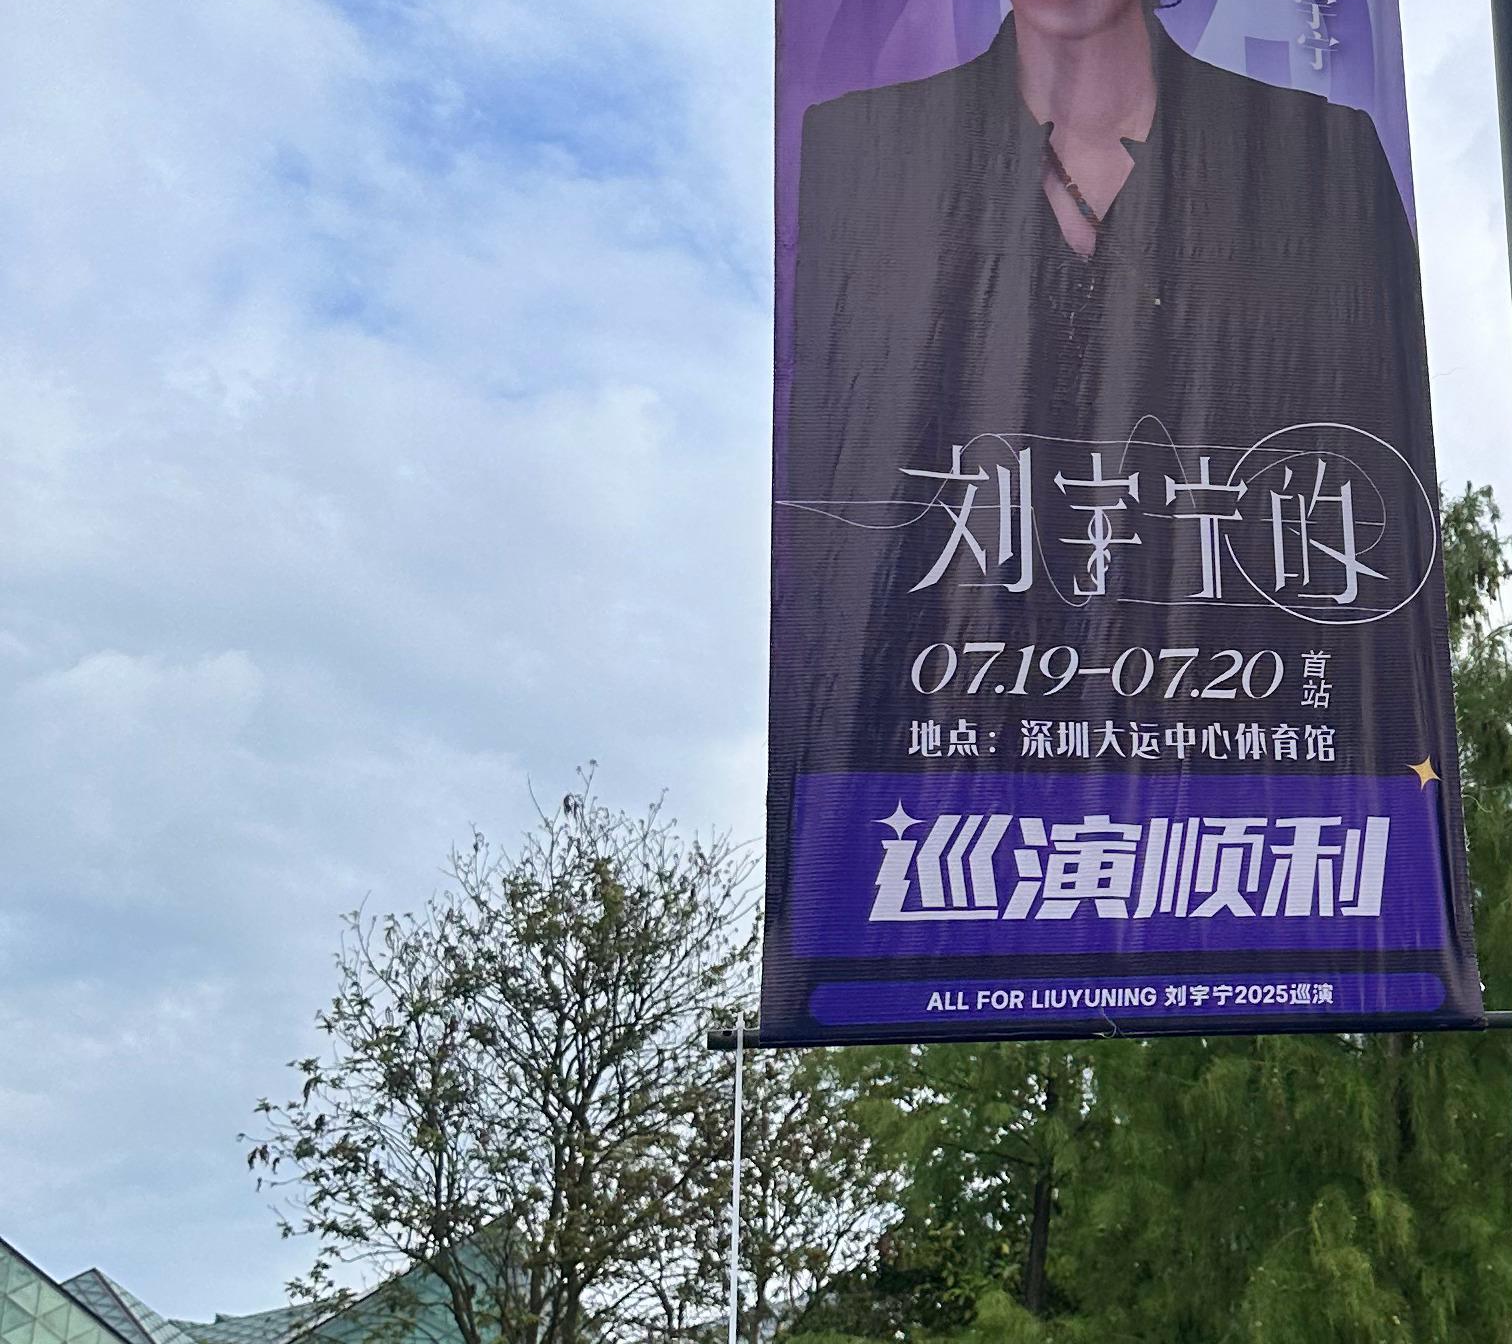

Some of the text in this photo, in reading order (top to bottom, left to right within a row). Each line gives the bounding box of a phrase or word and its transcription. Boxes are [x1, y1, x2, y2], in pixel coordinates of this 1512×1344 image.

[899, 444, 1390, 605] 刘宇宁的
[1300, 649, 1332, 710] 首站
[868, 811, 1391, 922] 巡演顺利
[926, 983, 1335, 1012] ALL FOR LIUYUNING 刘宇宁2025巡演
